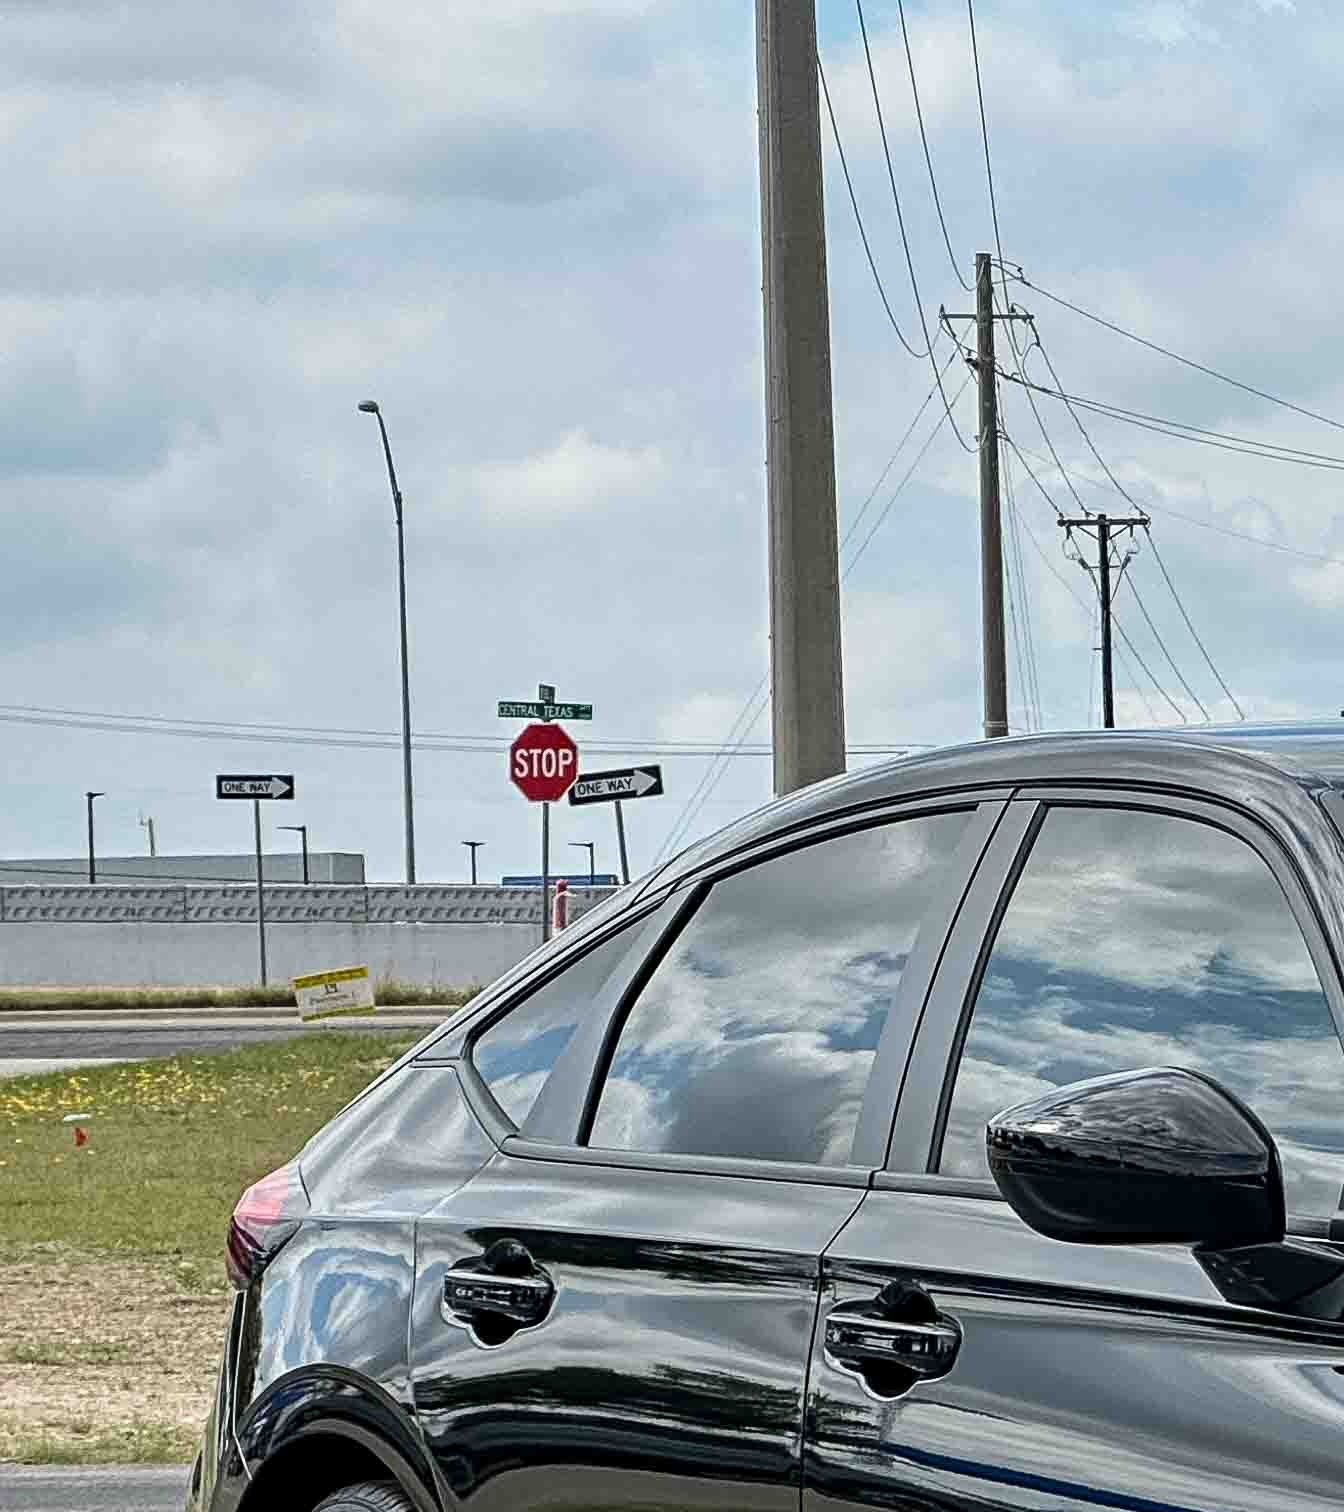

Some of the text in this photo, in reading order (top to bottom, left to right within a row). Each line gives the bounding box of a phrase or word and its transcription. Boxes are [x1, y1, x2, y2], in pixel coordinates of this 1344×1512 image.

[498, 703, 538, 717] CENTRAL
[543, 705, 574, 718] TEXAS
[515, 748, 573, 779] STOP
[223, 782, 271, 793] ONE WAY
[577, 778, 633, 796] ONE WAY
